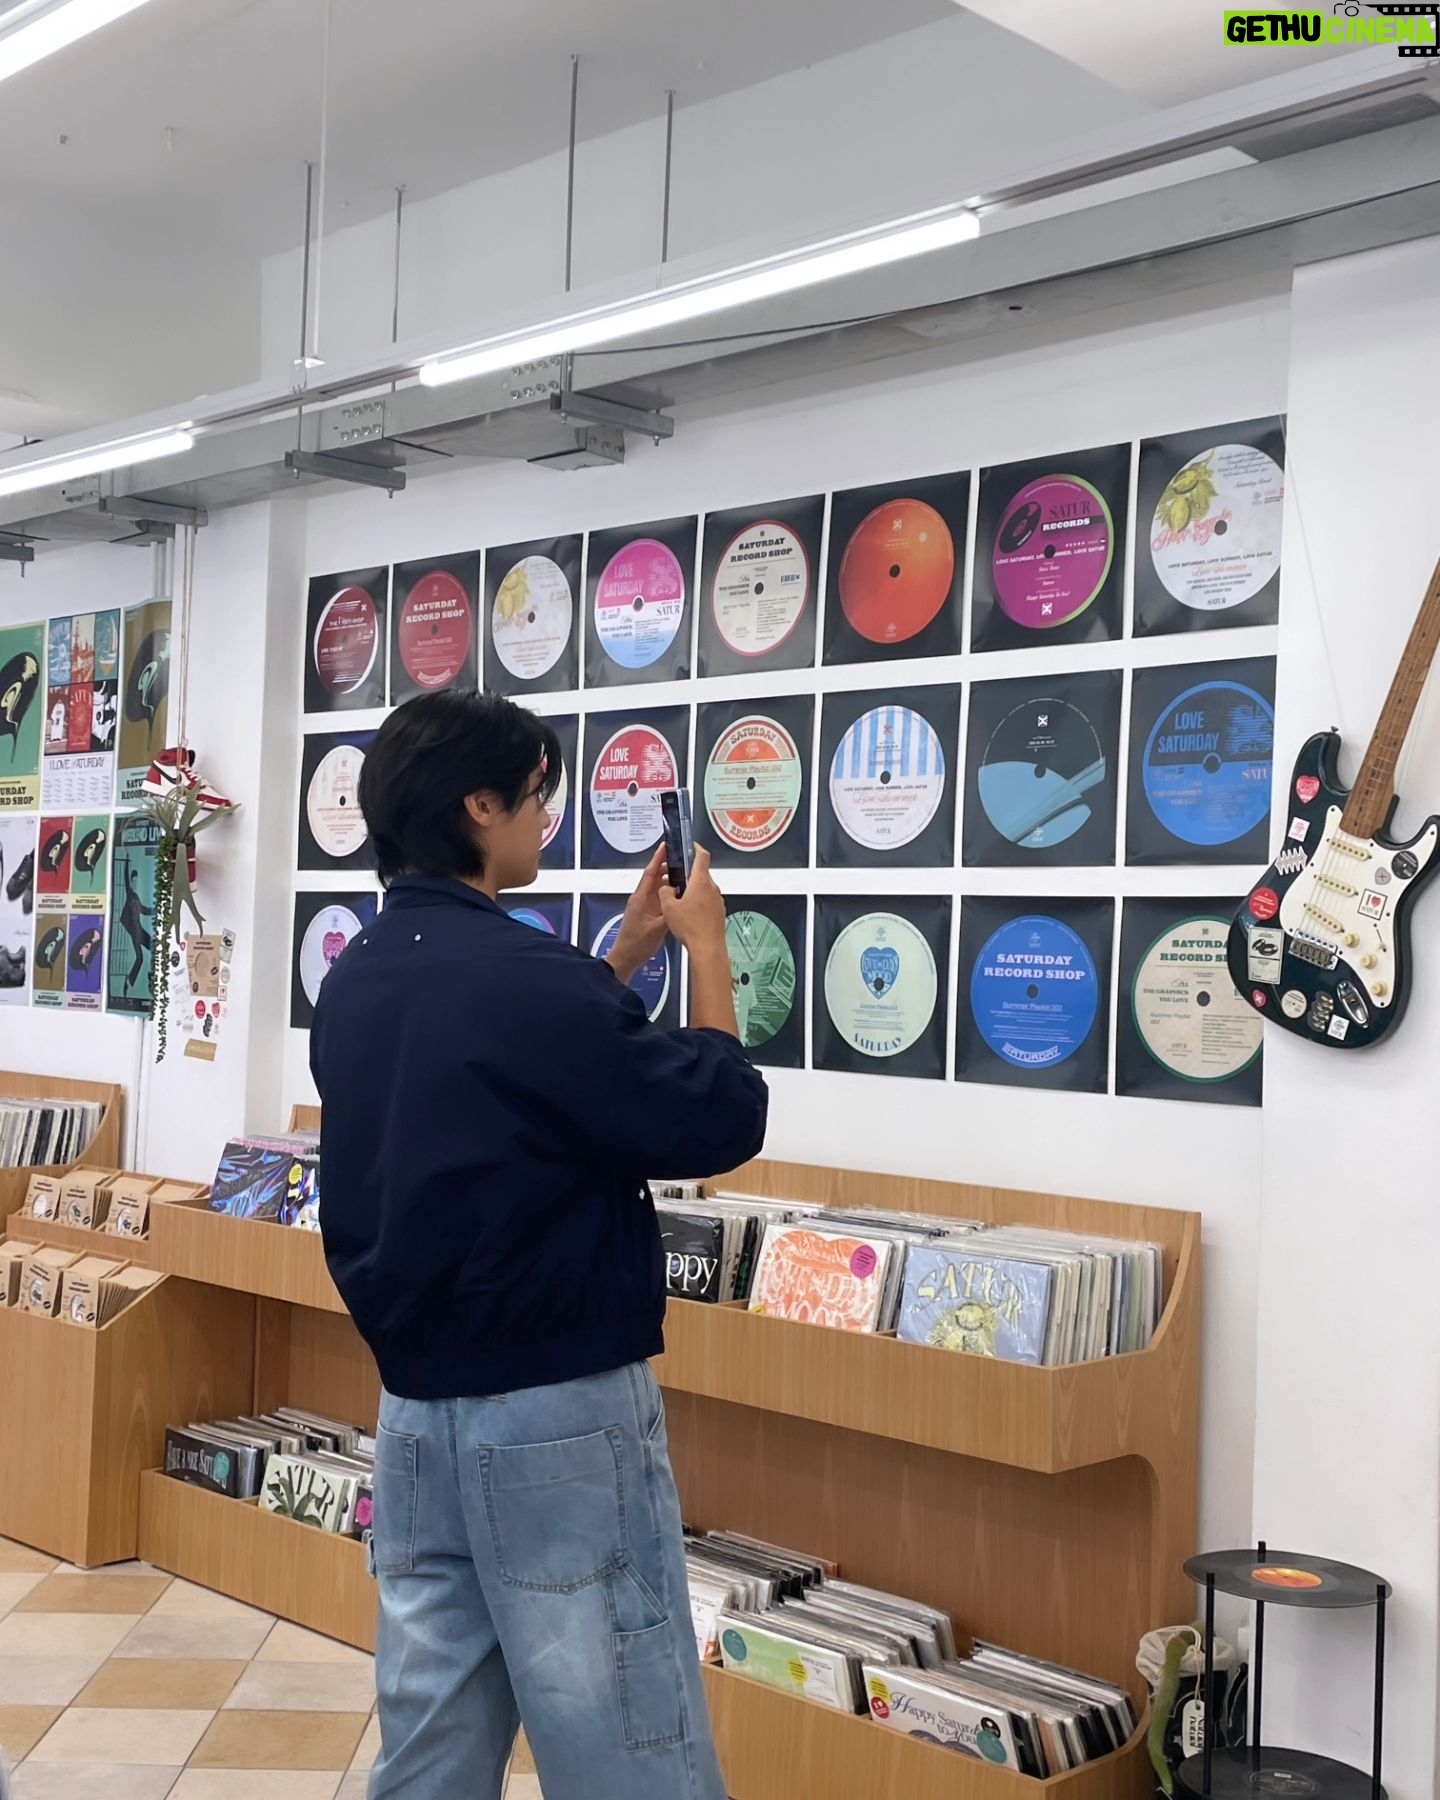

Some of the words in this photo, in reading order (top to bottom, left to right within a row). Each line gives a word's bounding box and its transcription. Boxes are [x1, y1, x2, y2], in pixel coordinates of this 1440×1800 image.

[1050, 501, 1091, 520] SATUR
[1042, 517, 1090, 532] RECORDS
[739, 537, 786, 550] SATURDAY
[730, 553, 767, 562] RECORD
[769, 548, 793, 557] SHOP
[614, 562, 634, 578] LOVE
[604, 578, 644, 598] SATURDAY
[413, 599, 457, 612] SATURDAY
[405, 612, 440, 623] RECORD
[441, 609, 465, 619] SHOP
[1175, 711, 1204, 730] LOVE
[730, 727, 777, 744] SATURDAY
[1159, 732, 1220, 753] SATURDAY
[610, 747, 629, 763] LOVE
[600, 765, 639, 780] SATURDAY
[126, 779, 143, 788] SATU
[13, 797, 34, 805] SHOP
[729, 825, 772, 840] RECORDS
[996, 953, 1073, 966] SATURDAY
[1160, 953, 1213, 962] RECORD
[984, 967, 1044, 979] RECORD
[1045, 969, 1086, 980] SHOP
[665, 1252, 718, 1294] ppy
[915, 1260, 1022, 1337] SATUR
[889, 1691, 936, 1725] Happy
[937, 1724, 950, 1736] to
